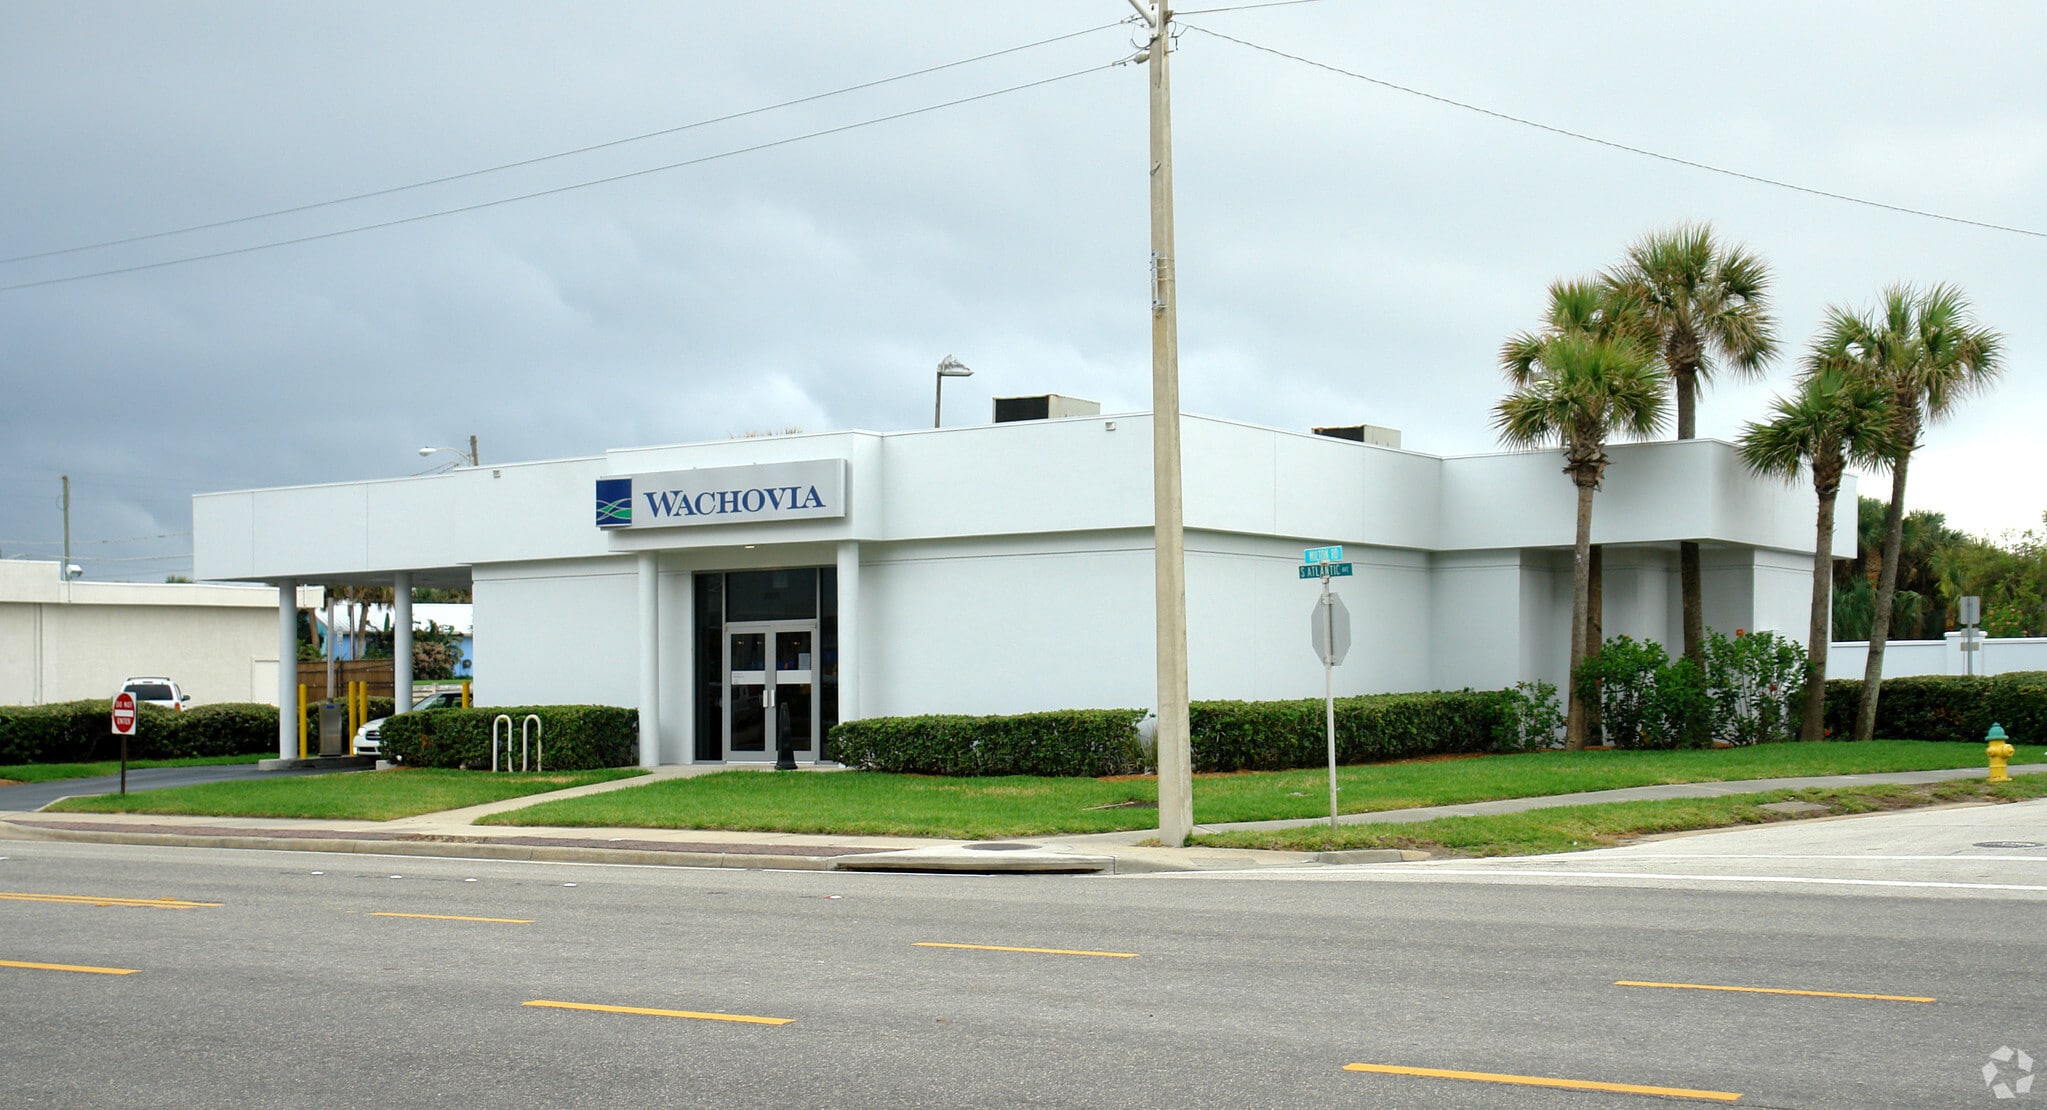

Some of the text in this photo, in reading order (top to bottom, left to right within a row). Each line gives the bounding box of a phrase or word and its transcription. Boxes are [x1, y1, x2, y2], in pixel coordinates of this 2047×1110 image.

[643, 485, 826, 518] WACHOVIA
[1300, 567, 1306, 577] S
[1307, 564, 1341, 577] ATLANTIC
[116, 717, 131, 725] ENTER
